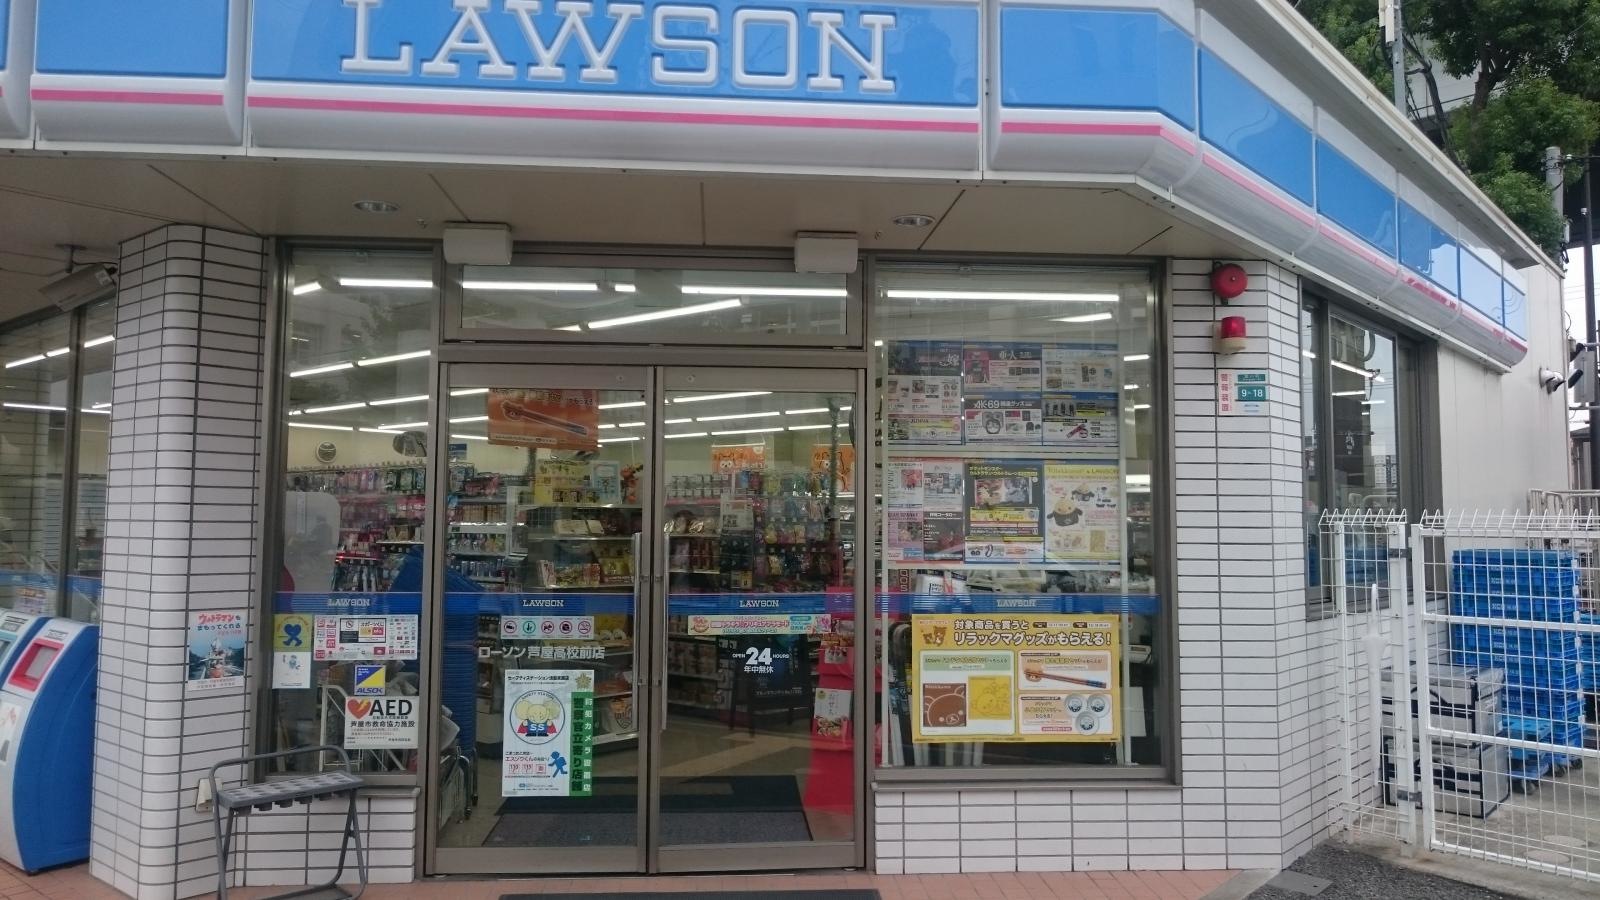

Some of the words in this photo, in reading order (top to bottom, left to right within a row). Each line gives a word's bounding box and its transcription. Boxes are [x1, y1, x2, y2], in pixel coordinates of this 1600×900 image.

[340, 0, 896, 94] LAWSON
[327, 599, 370, 607] LAWSON
[739, 600, 779, 608] LAWSON
[997, 599, 1036, 607] LAWSON
[954, 620, 1029, 630] 対象商品を買うと
[745, 647, 773, 665] 24
[743, 666, 774, 674] 年中無休
[369, 699, 413, 717] AED
[529, 723, 545, 731] SS
